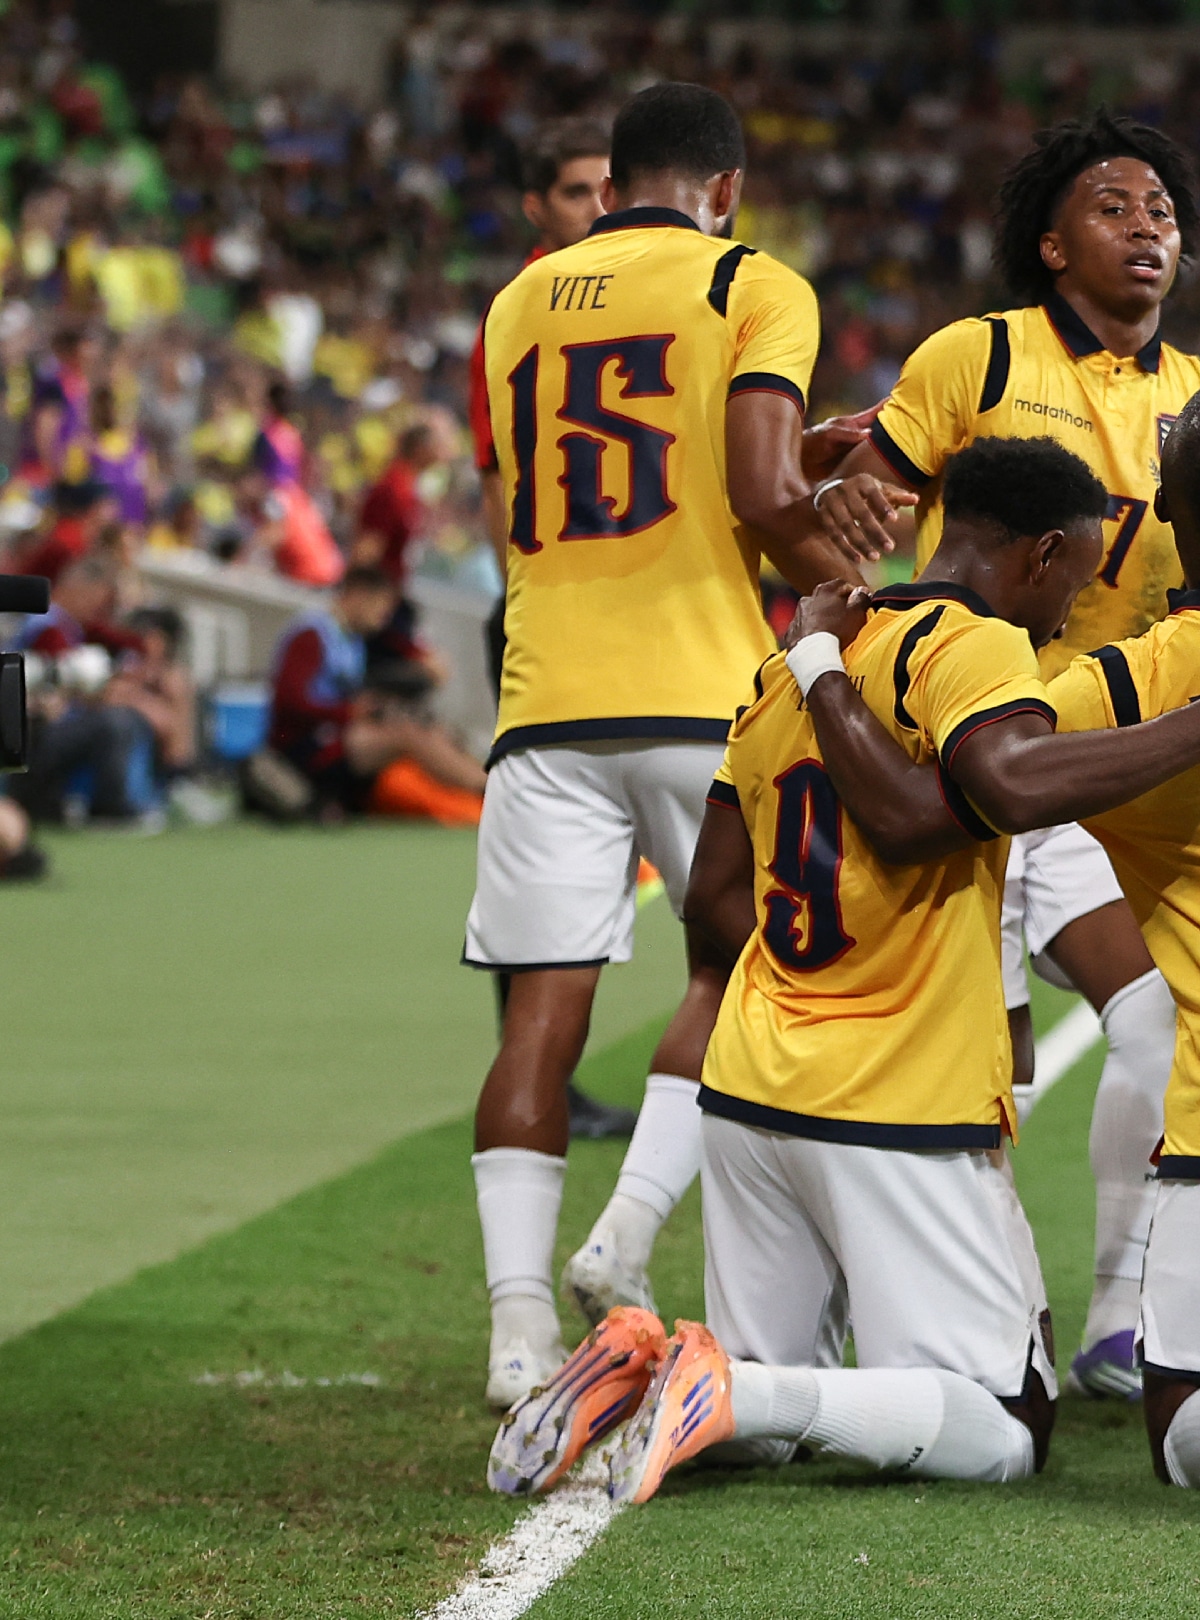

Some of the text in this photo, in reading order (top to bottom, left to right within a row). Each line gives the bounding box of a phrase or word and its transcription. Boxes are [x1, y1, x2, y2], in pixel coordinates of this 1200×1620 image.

[549, 274, 614, 312] VITE
[507, 333, 678, 556] 15
[1014, 398, 1093, 433] marathon
[762, 757, 857, 973] 9
